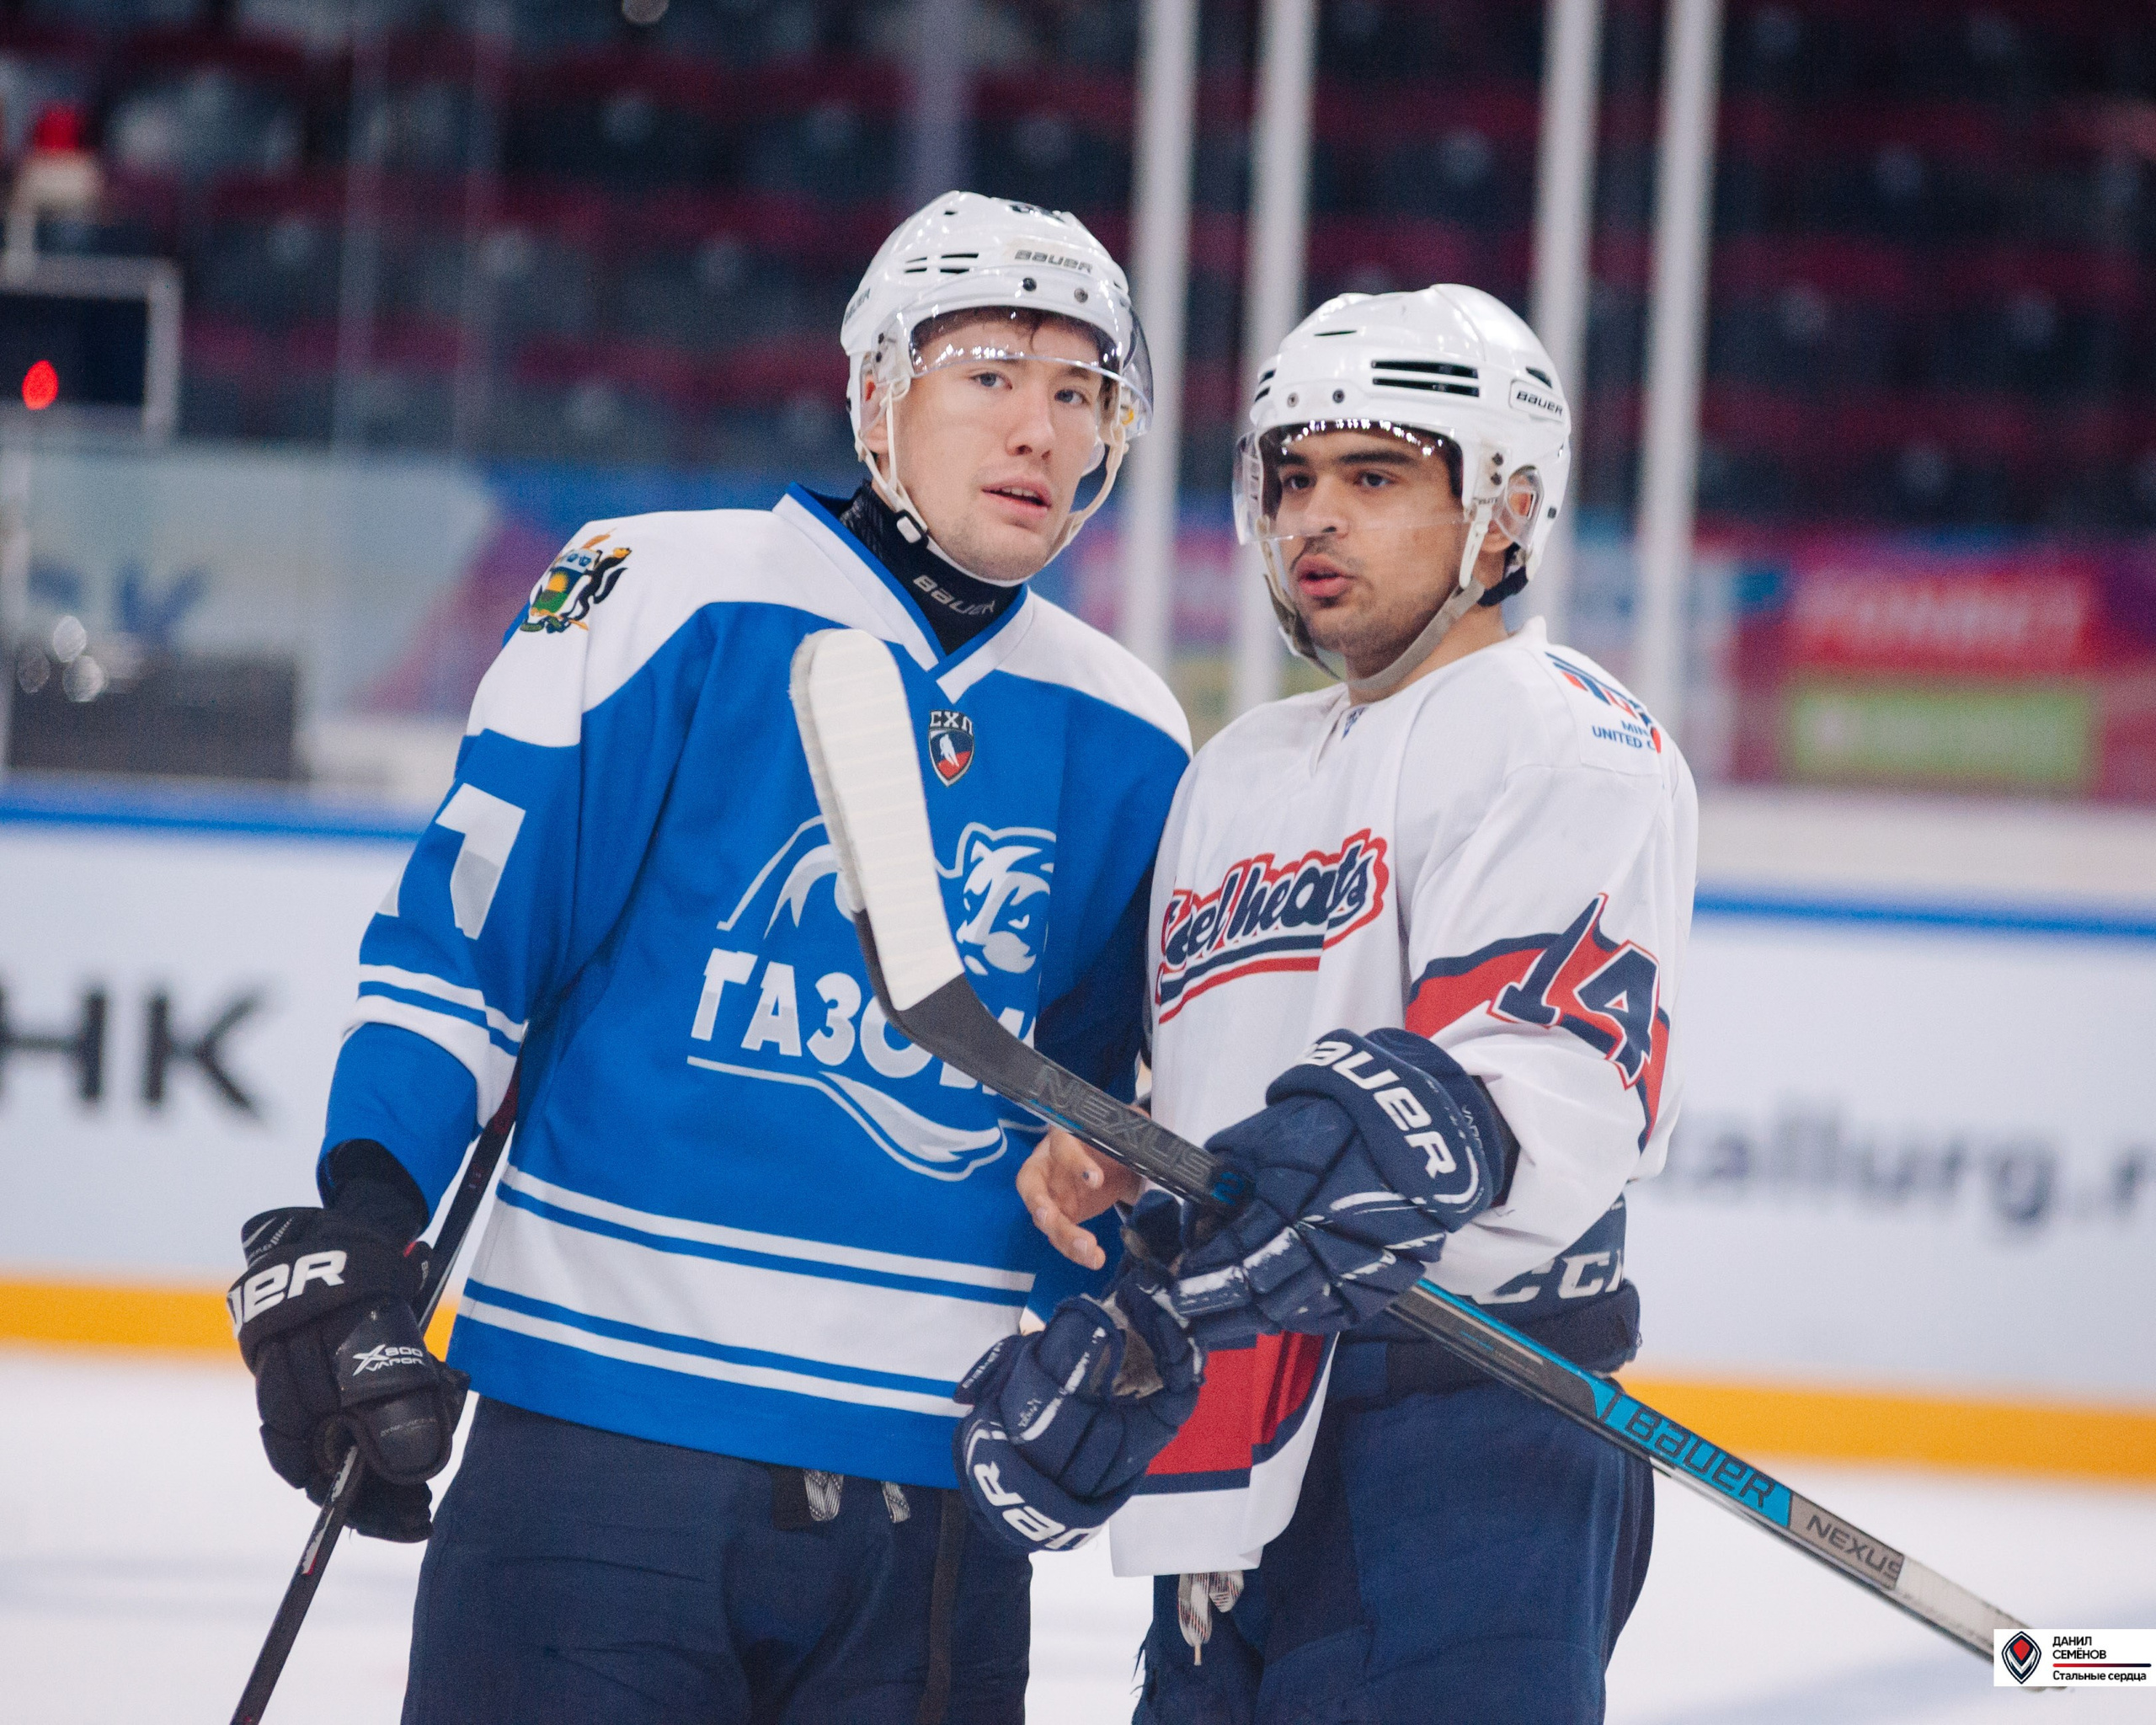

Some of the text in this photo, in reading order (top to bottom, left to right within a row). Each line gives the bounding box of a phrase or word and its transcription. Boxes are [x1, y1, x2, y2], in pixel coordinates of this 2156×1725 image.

[1014, 248, 1093, 275] BAUER
[1516, 389, 1564, 417] BAUER
[1592, 725, 1643, 749] UNITED
[691, 948, 1036, 1096] ГАЗО
[1493, 894, 1659, 1087] 14
[1028, 1065, 1219, 1189] NEXUS
[1297, 1040, 1457, 1180] AUER
[365, 1356, 426, 1372] VAPOR
[1625, 1404, 1774, 1510] BAUER
